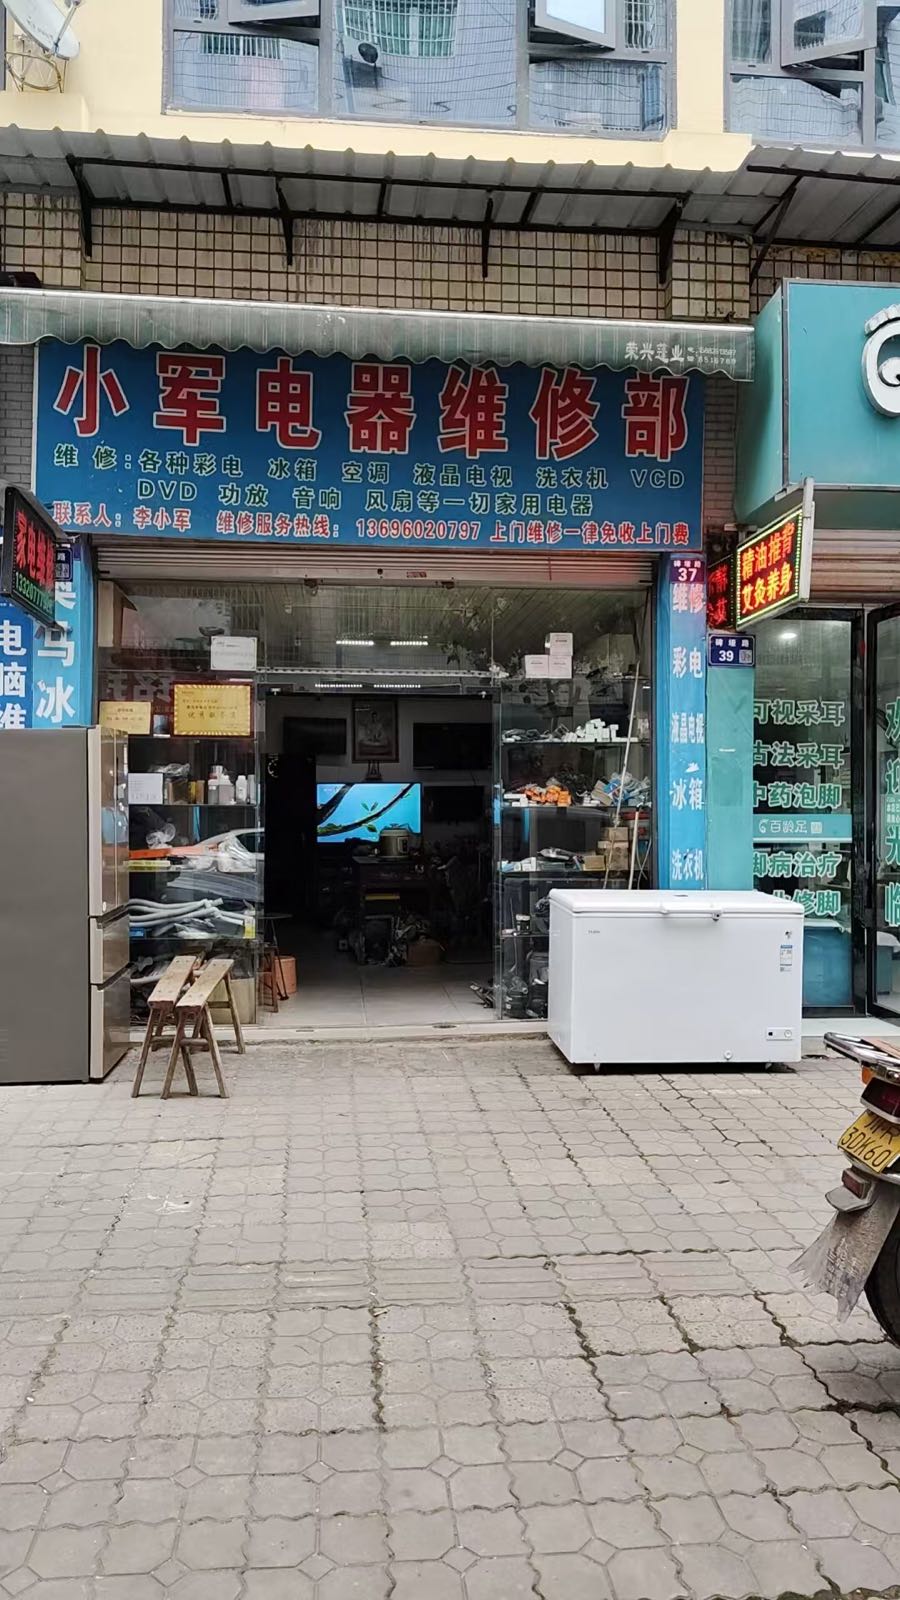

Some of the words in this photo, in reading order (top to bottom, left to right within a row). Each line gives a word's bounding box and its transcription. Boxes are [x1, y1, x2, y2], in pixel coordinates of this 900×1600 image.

[53, 344, 689, 462] 小军电器维修部
[268, 458, 318, 481] 冰箱
[341, 462, 391, 484] 空调
[413, 463, 514, 488] 液晶电视
[535, 466, 609, 490] 洗衣机
[631, 468, 686, 489] VCD
[137, 480, 198, 502] DVD
[218, 484, 269, 508] 功放
[294, 487, 342, 510] 音响
[365, 491, 594, 518] 风扇等一切家用电器
[490, 521, 690, 546] 上门维修一律免收上门费
[741, 522, 796, 582] 精油推背
[678, 568, 698, 582] 37
[741, 561, 793, 615] 艾灸养身
[672, 584, 705, 614] 维修
[673, 646, 703, 679] 彩电
[718, 650, 734, 662] 39
[671, 712, 704, 744] 液晶电视
[671, 778, 704, 811] 冰箱
[671, 849, 704, 881] 洗衣机
[841, 1127, 892, 1168] 3DK60
